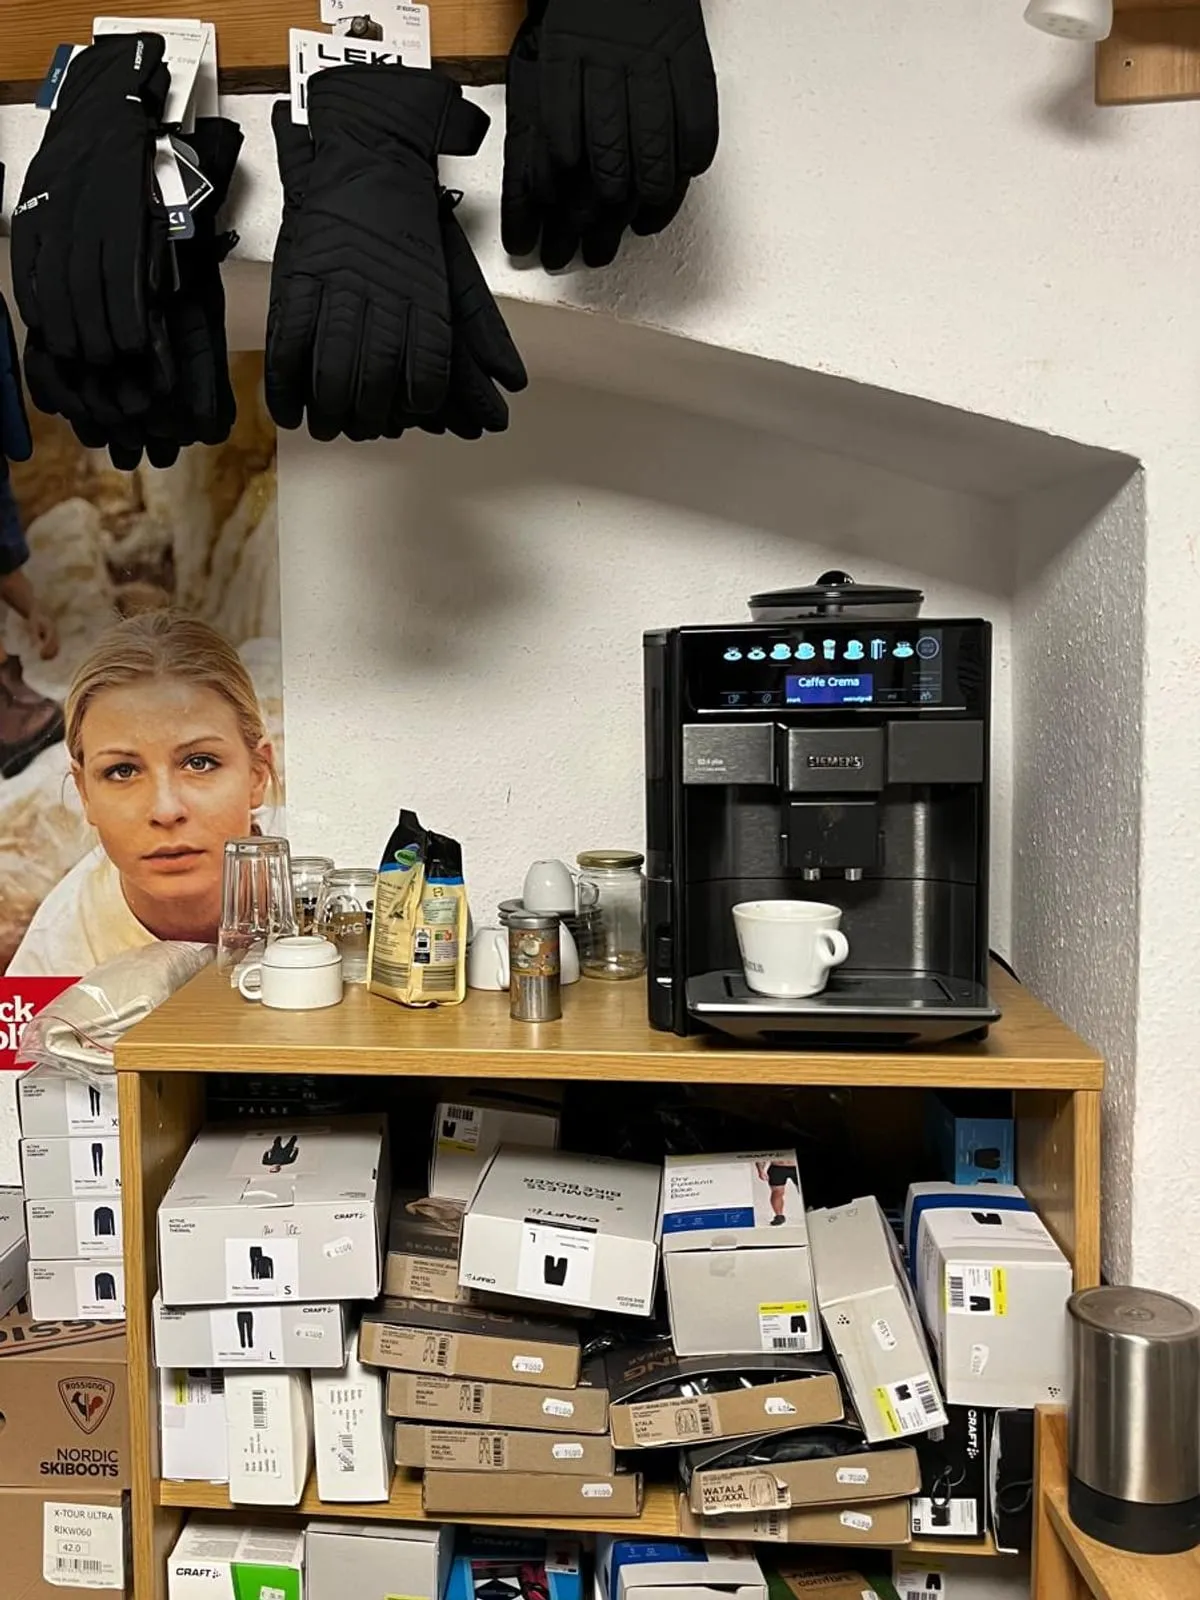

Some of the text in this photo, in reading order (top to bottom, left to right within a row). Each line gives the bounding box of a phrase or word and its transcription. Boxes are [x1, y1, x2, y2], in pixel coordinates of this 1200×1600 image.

[318, 43, 402, 65] LEKI
[14, 192, 49, 215] LEKI
[798, 677, 860, 687] Caffe Crema
[807, 755, 864, 769] SIEMENS
[0, 995, 35, 1022] ck
[334, 1212, 359, 1220] CRAFT
[284, 1285, 292, 1295] S
[302, 1306, 327, 1314] CRAFT
[269, 1351, 276, 1360] L
[967, 1409, 978, 1448] CRAFT
[56, 1448, 119, 1462] NORDIC
[40, 1462, 119, 1477] SKIBOOTS
[703, 1484, 744, 1496] WATALA
[703, 1493, 750, 1504] XXL/XXXL
[54, 1509, 114, 1521] X-TOUR ULTRA
[62, 1543, 82, 1553] 42.0
[175, 1567, 212, 1577] CRAFT
